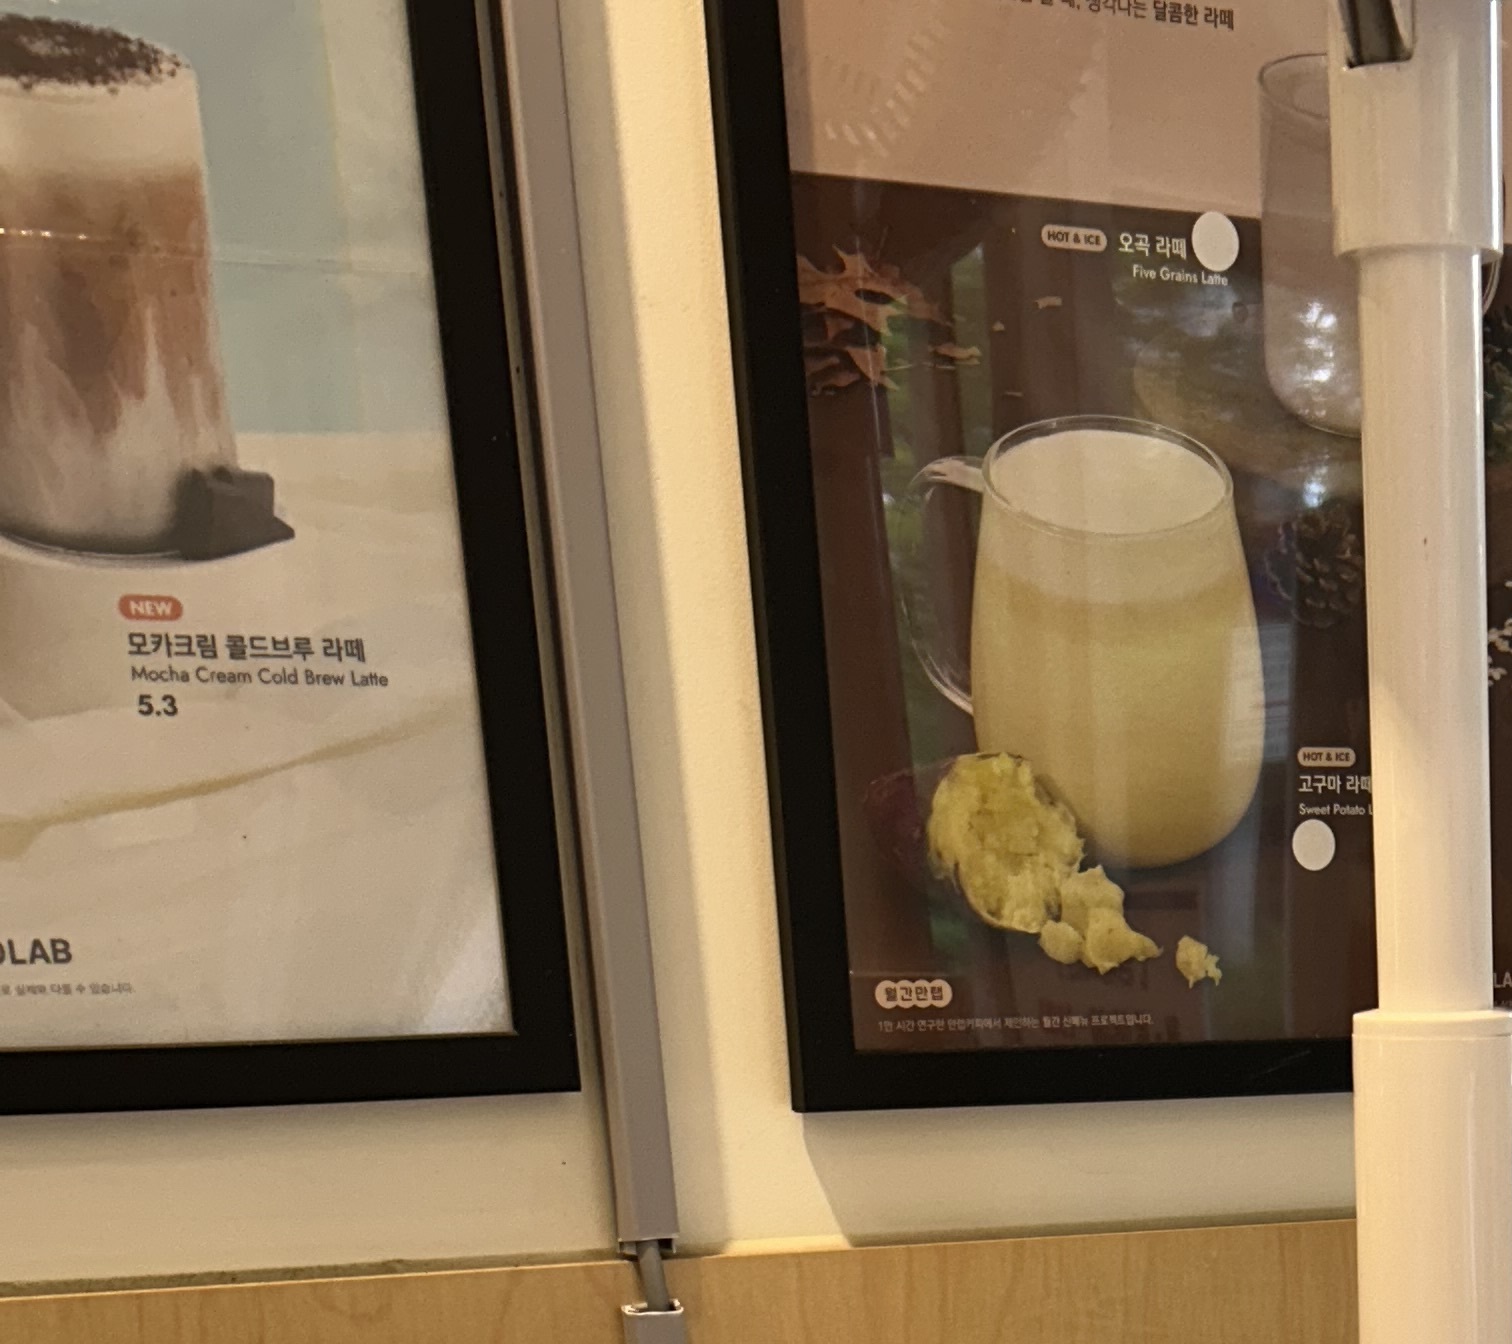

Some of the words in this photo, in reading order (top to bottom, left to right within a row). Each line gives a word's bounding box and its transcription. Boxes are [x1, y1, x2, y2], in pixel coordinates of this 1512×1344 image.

[1153, 1, 1199, 26] 달콤한
[1204, 7, 1235, 30] 라떼
[1047, 229, 1070, 244] HOT
[1073, 232, 1081, 243] &
[1084, 233, 1102, 246] ICE
[1119, 232, 1150, 257] 오곡
[1155, 236, 1186, 260] 라떼
[1133, 264, 1156, 280] Five
[1160, 267, 1198, 283] Grains
[1201, 271, 1229, 286] Latte
[130, 601, 172, 616] NEW
[128, 632, 218, 659] 모카크림
[225, 634, 314, 661] 콜드브루
[322, 638, 366, 662] 라떼
[131, 665, 190, 683] Mocha
[195, 666, 252, 684] Cream
[258, 667, 299, 685] Cold
[305, 669, 344, 686] Brew
[351, 670, 389, 687] Latte
[138, 694, 178, 717] 5.3
[1303, 752, 1323, 762] HOT
[1325, 752, 1333, 762] &
[1335, 752, 1350, 762] ICE
[1298, 775, 1342, 795] 고구마
[1299, 804, 1331, 816] Sweet
[1333, 804, 1365, 816] Potato
